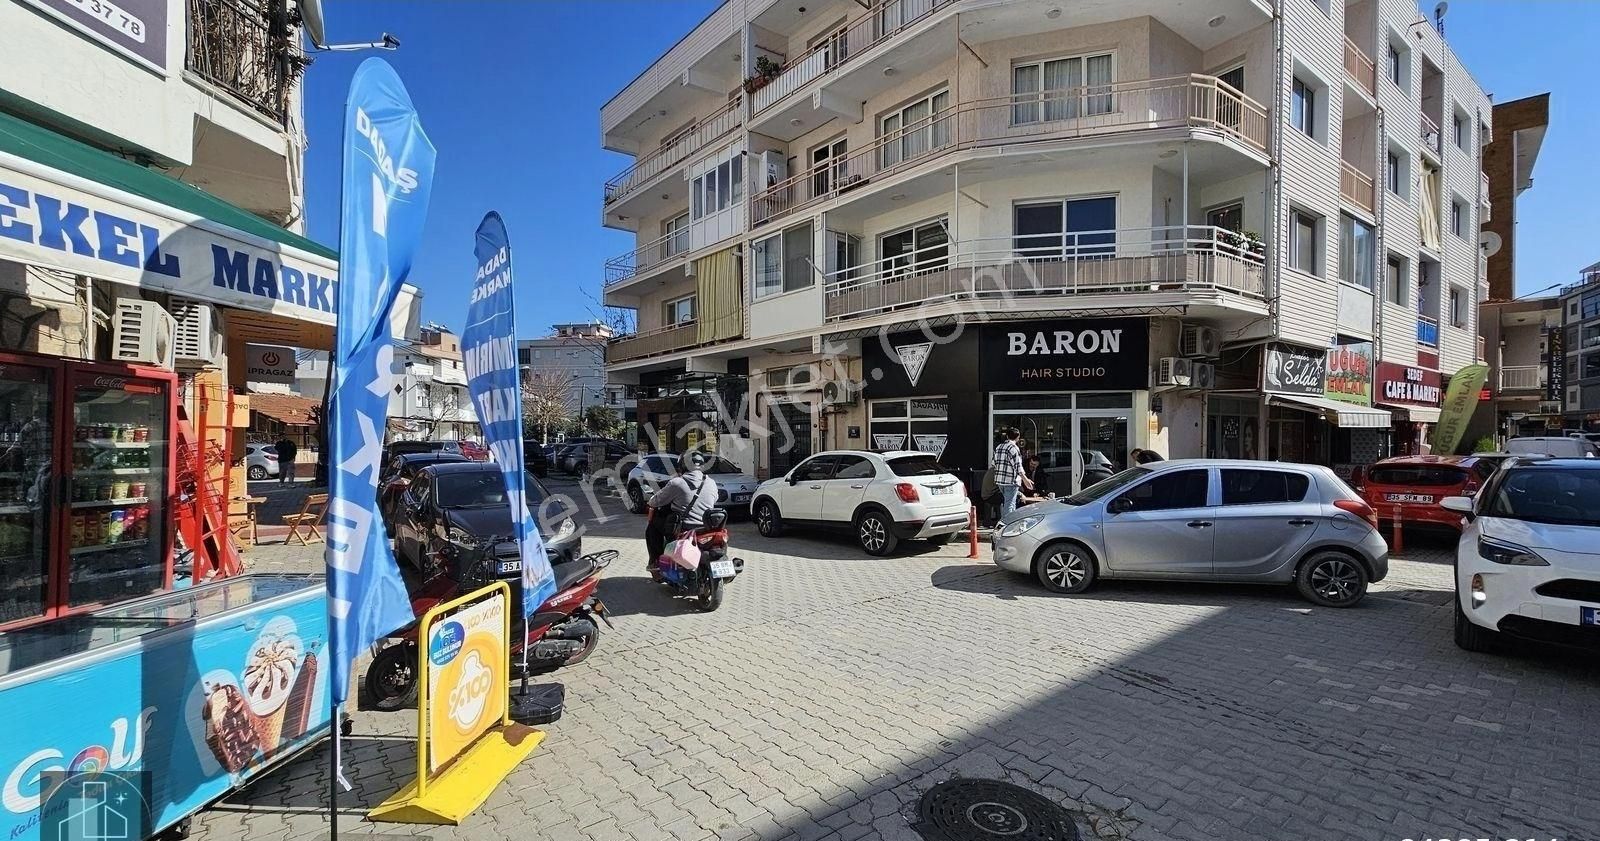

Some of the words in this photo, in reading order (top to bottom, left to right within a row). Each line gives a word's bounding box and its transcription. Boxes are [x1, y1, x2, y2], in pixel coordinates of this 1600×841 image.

[90, 0, 113, 19] 37
[119, 14, 141, 36] 78
[356, 106, 419, 194] DADAŞ
[211, 243, 338, 315] MARK
[1007, 329, 1123, 356] BARON
[1021, 368, 1052, 379] HAIR
[1055, 367, 1106, 378] STUDIO
[1283, 360, 1318, 386] Selda
[1329, 345, 1368, 377] UĞUR
[1327, 377, 1367, 396] EMLAK
[1386, 381, 1406, 399] CAFE
[1407, 383, 1413, 400] &
[1413, 384, 1440, 403] MARKET
[920, 444, 943, 452] BARON
[503, 563, 515, 571] 35
